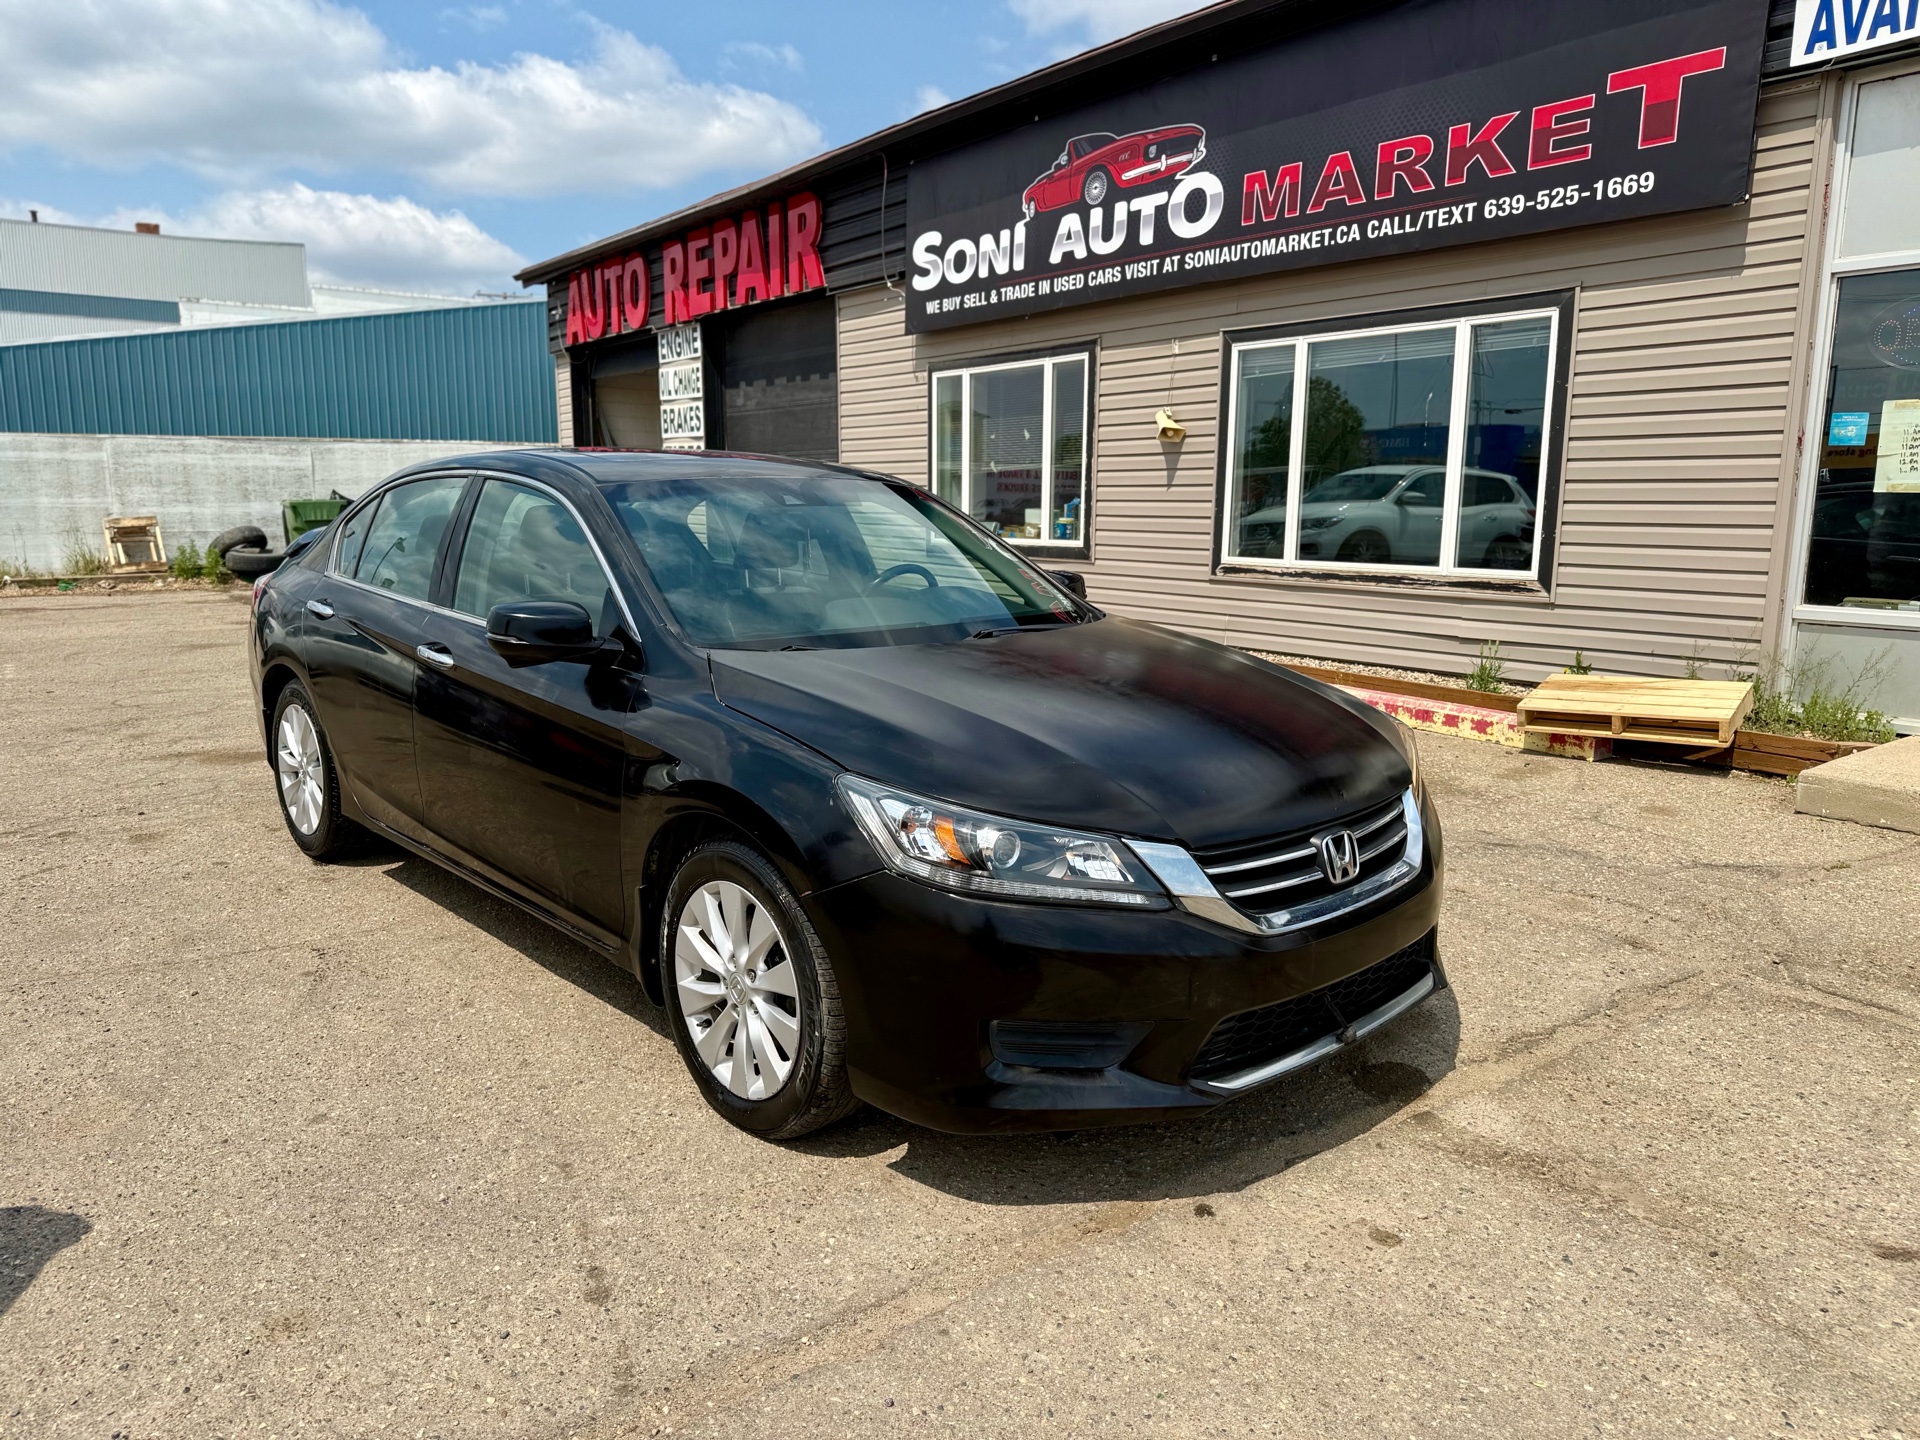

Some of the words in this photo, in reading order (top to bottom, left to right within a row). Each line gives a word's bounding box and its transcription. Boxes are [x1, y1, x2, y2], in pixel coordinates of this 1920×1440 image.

[911, 219, 1027, 292] SONI
[1048, 171, 1225, 265] AUTO
[1241, 46, 1727, 226] MARKET
[565, 251, 650, 346] AUTO
[662, 191, 827, 325] REPAIR
[926, 299, 940, 314] WE
[942, 296, 962, 312] BUY
[963, 291, 987, 309] SELL
[989, 289, 998, 304] &
[1000, 282, 1036, 302] TRADE
[1038, 280, 1050, 296] IN
[1053, 273, 1084, 293] USED
[1088, 267, 1121, 287] CARS
[1124, 259, 1160, 281] VISIT
[1162, 255, 1181, 274] AT
[1184, 222, 1361, 270] SONIAUTOMARKET.CA
[1366, 201, 1478, 240] CALL/TEXT
[1483, 171, 1656, 219] 639-525-1669
[659, 326, 700, 361] ENGINE
[660, 370, 672, 397] OIL
[673, 366, 700, 396] CHANGE
[662, 405, 702, 435] BRAKES
